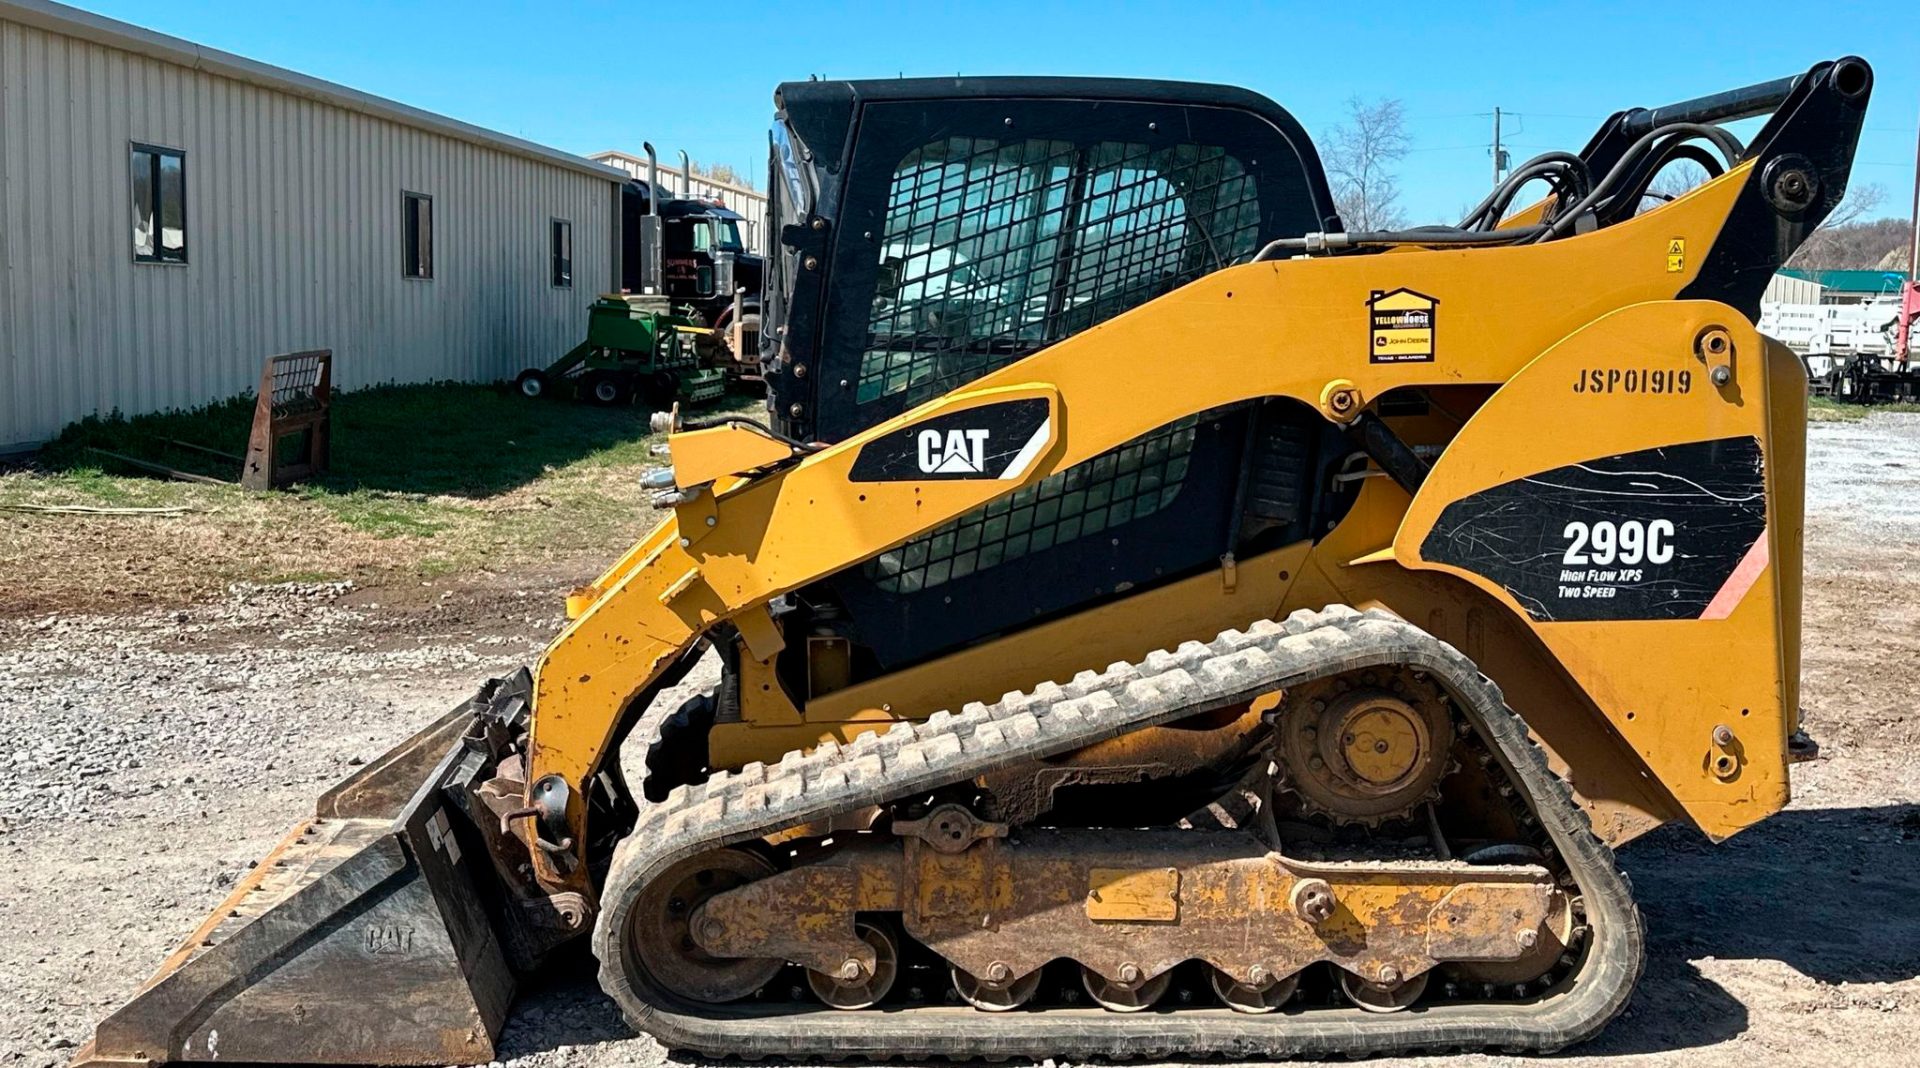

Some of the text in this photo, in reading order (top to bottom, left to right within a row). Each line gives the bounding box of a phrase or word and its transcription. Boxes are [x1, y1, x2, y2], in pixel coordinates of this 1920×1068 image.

[1374, 312, 1429, 325] YELLOWHOUSE
[1572, 368, 1692, 395] JSP01919
[917, 428, 990, 474] CAT
[1562, 518, 1675, 566] 299C
[1559, 568, 1643, 582] HIGH FLOW XPS
[1558, 585, 1617, 598] TWO SPEED
[364, 925, 416, 955] CAT
